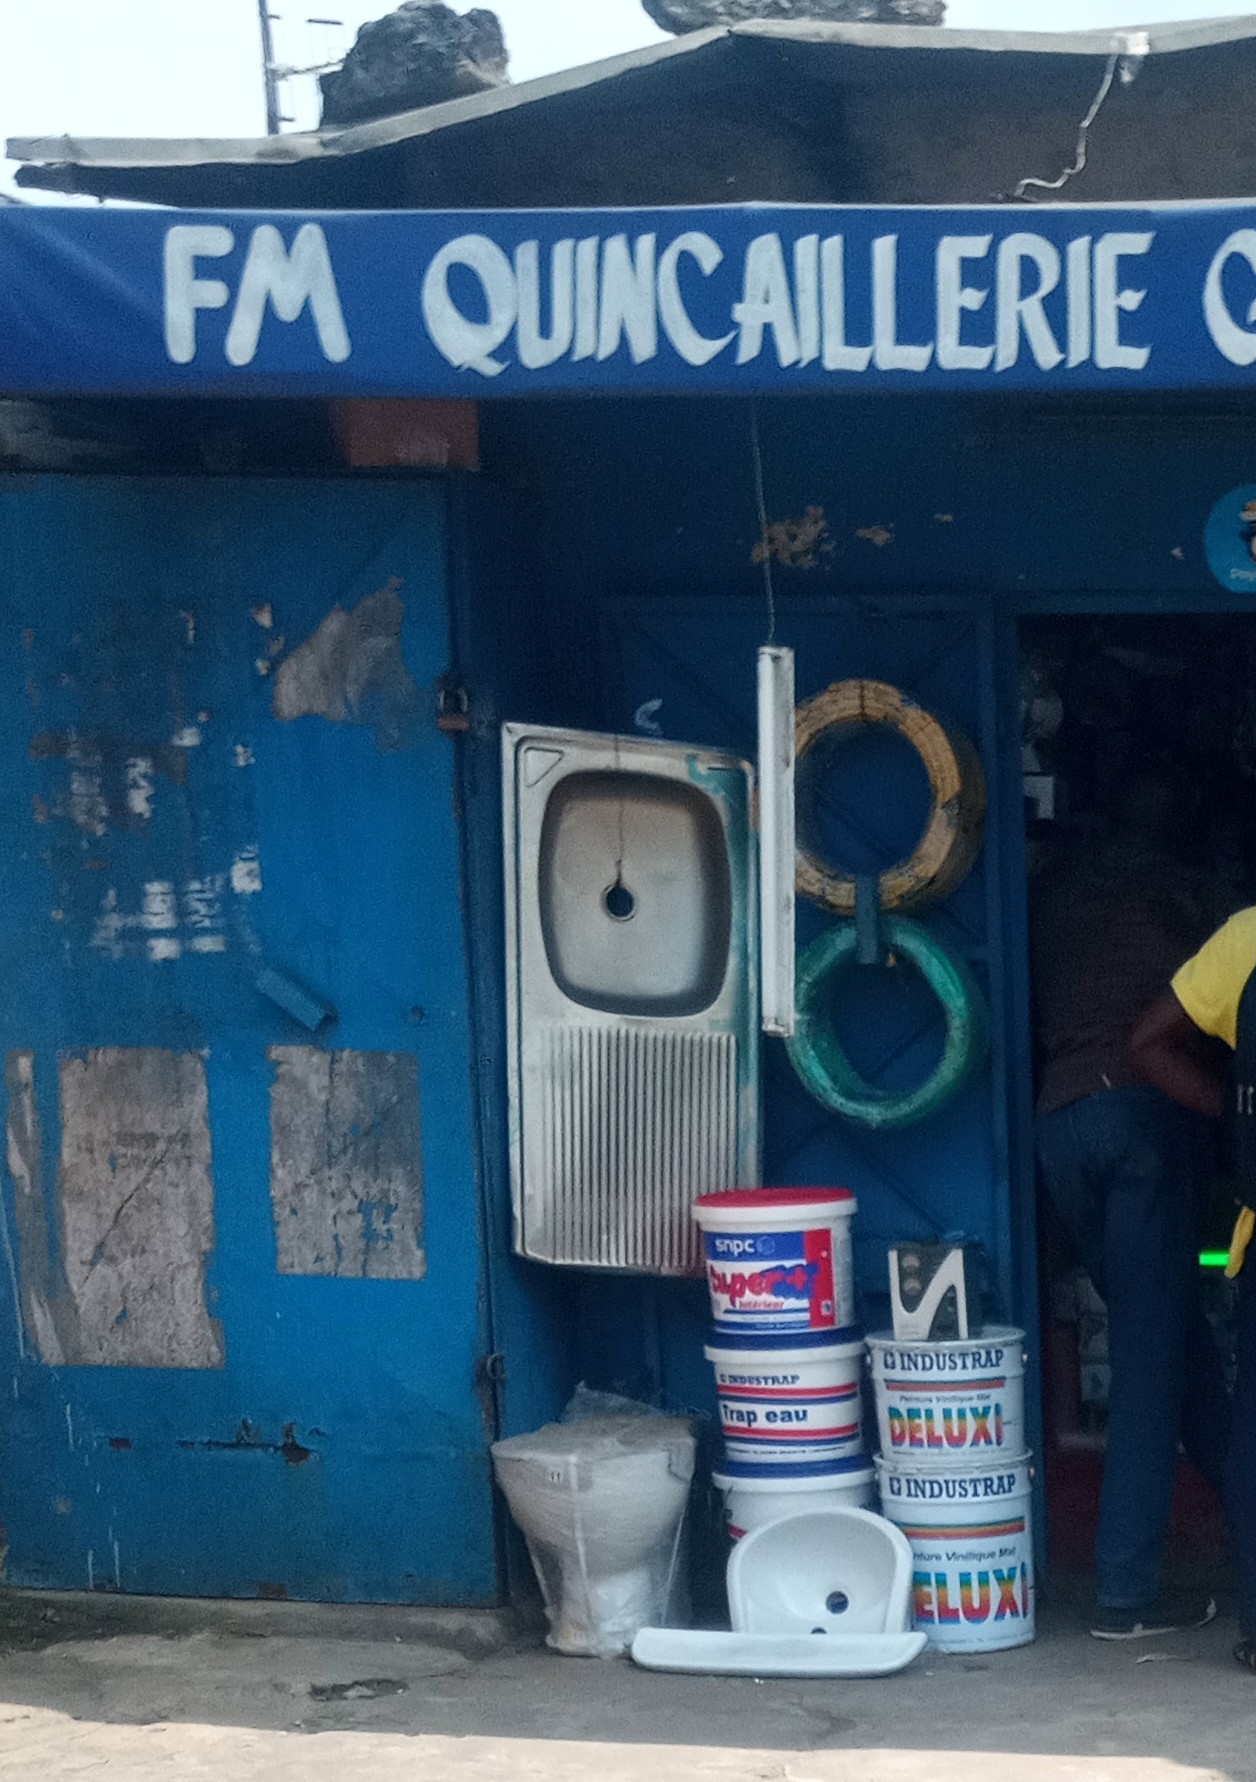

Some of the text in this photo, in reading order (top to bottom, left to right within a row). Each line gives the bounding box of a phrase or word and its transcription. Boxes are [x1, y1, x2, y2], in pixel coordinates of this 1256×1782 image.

[163, 223, 353, 367] FM
[421, 231, 1157, 377] QUINCAILLERIE
[714, 1238, 756, 1257] snpc
[899, 1348, 1004, 1372] INDUSTRAP
[728, 1373, 801, 1386] INDUSTRAP
[722, 1404, 809, 1428] Trap eau
[905, 1473, 1017, 1499] INDUSTRAP
